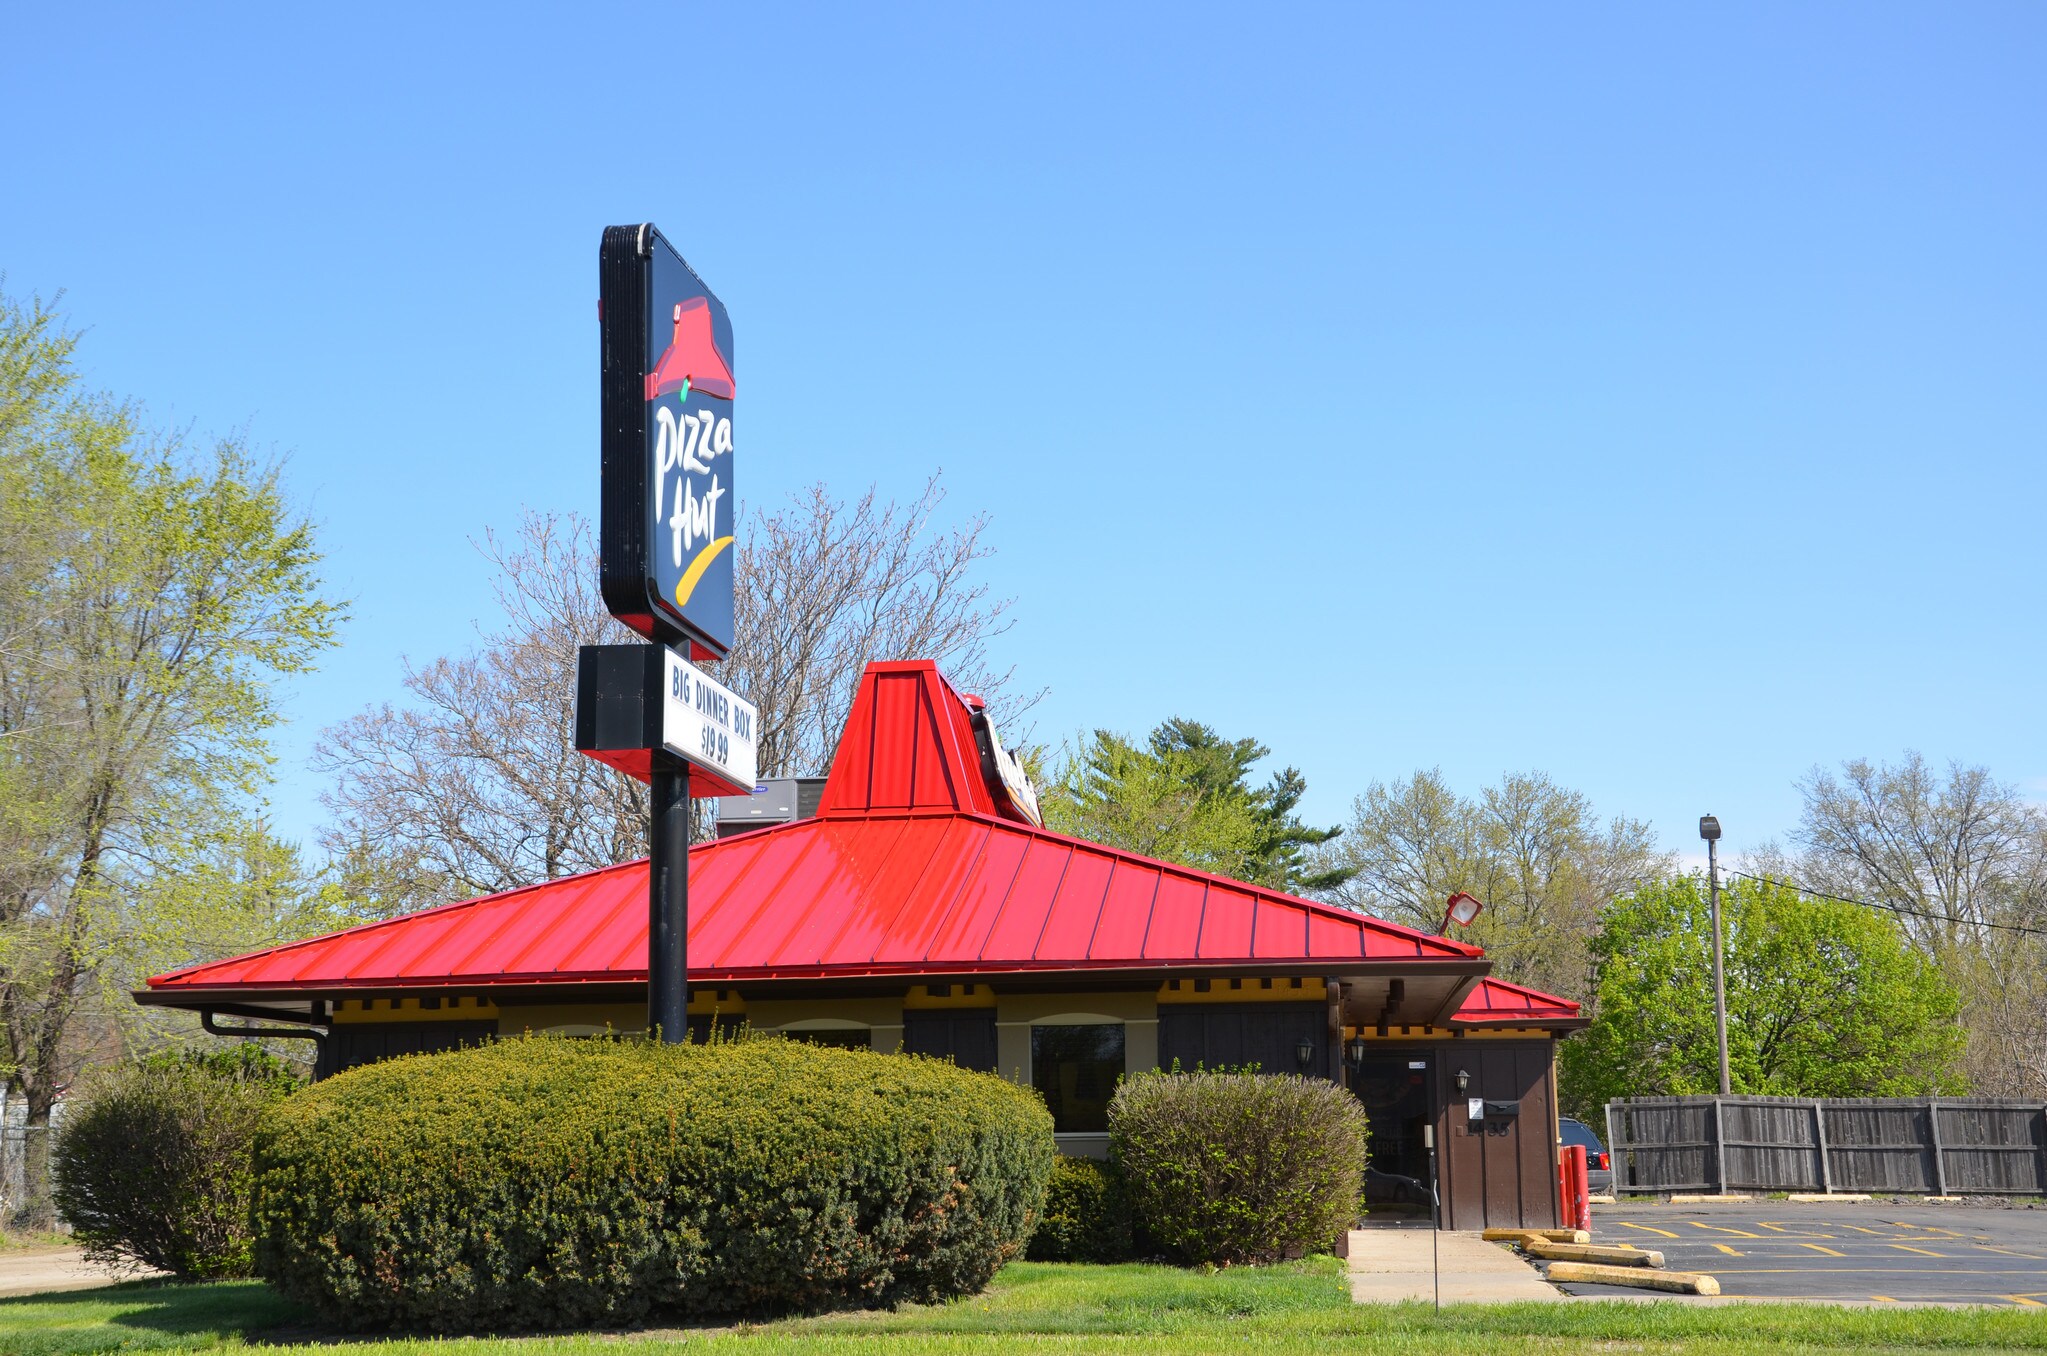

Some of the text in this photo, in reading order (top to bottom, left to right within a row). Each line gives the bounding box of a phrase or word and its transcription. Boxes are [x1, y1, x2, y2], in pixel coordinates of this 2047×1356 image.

[655, 405, 733, 524] Pizza
[669, 473, 725, 568] Hut
[672, 665, 751, 742] BIG DINNER BOX
[1466, 1121, 1510, 1137] 1435
